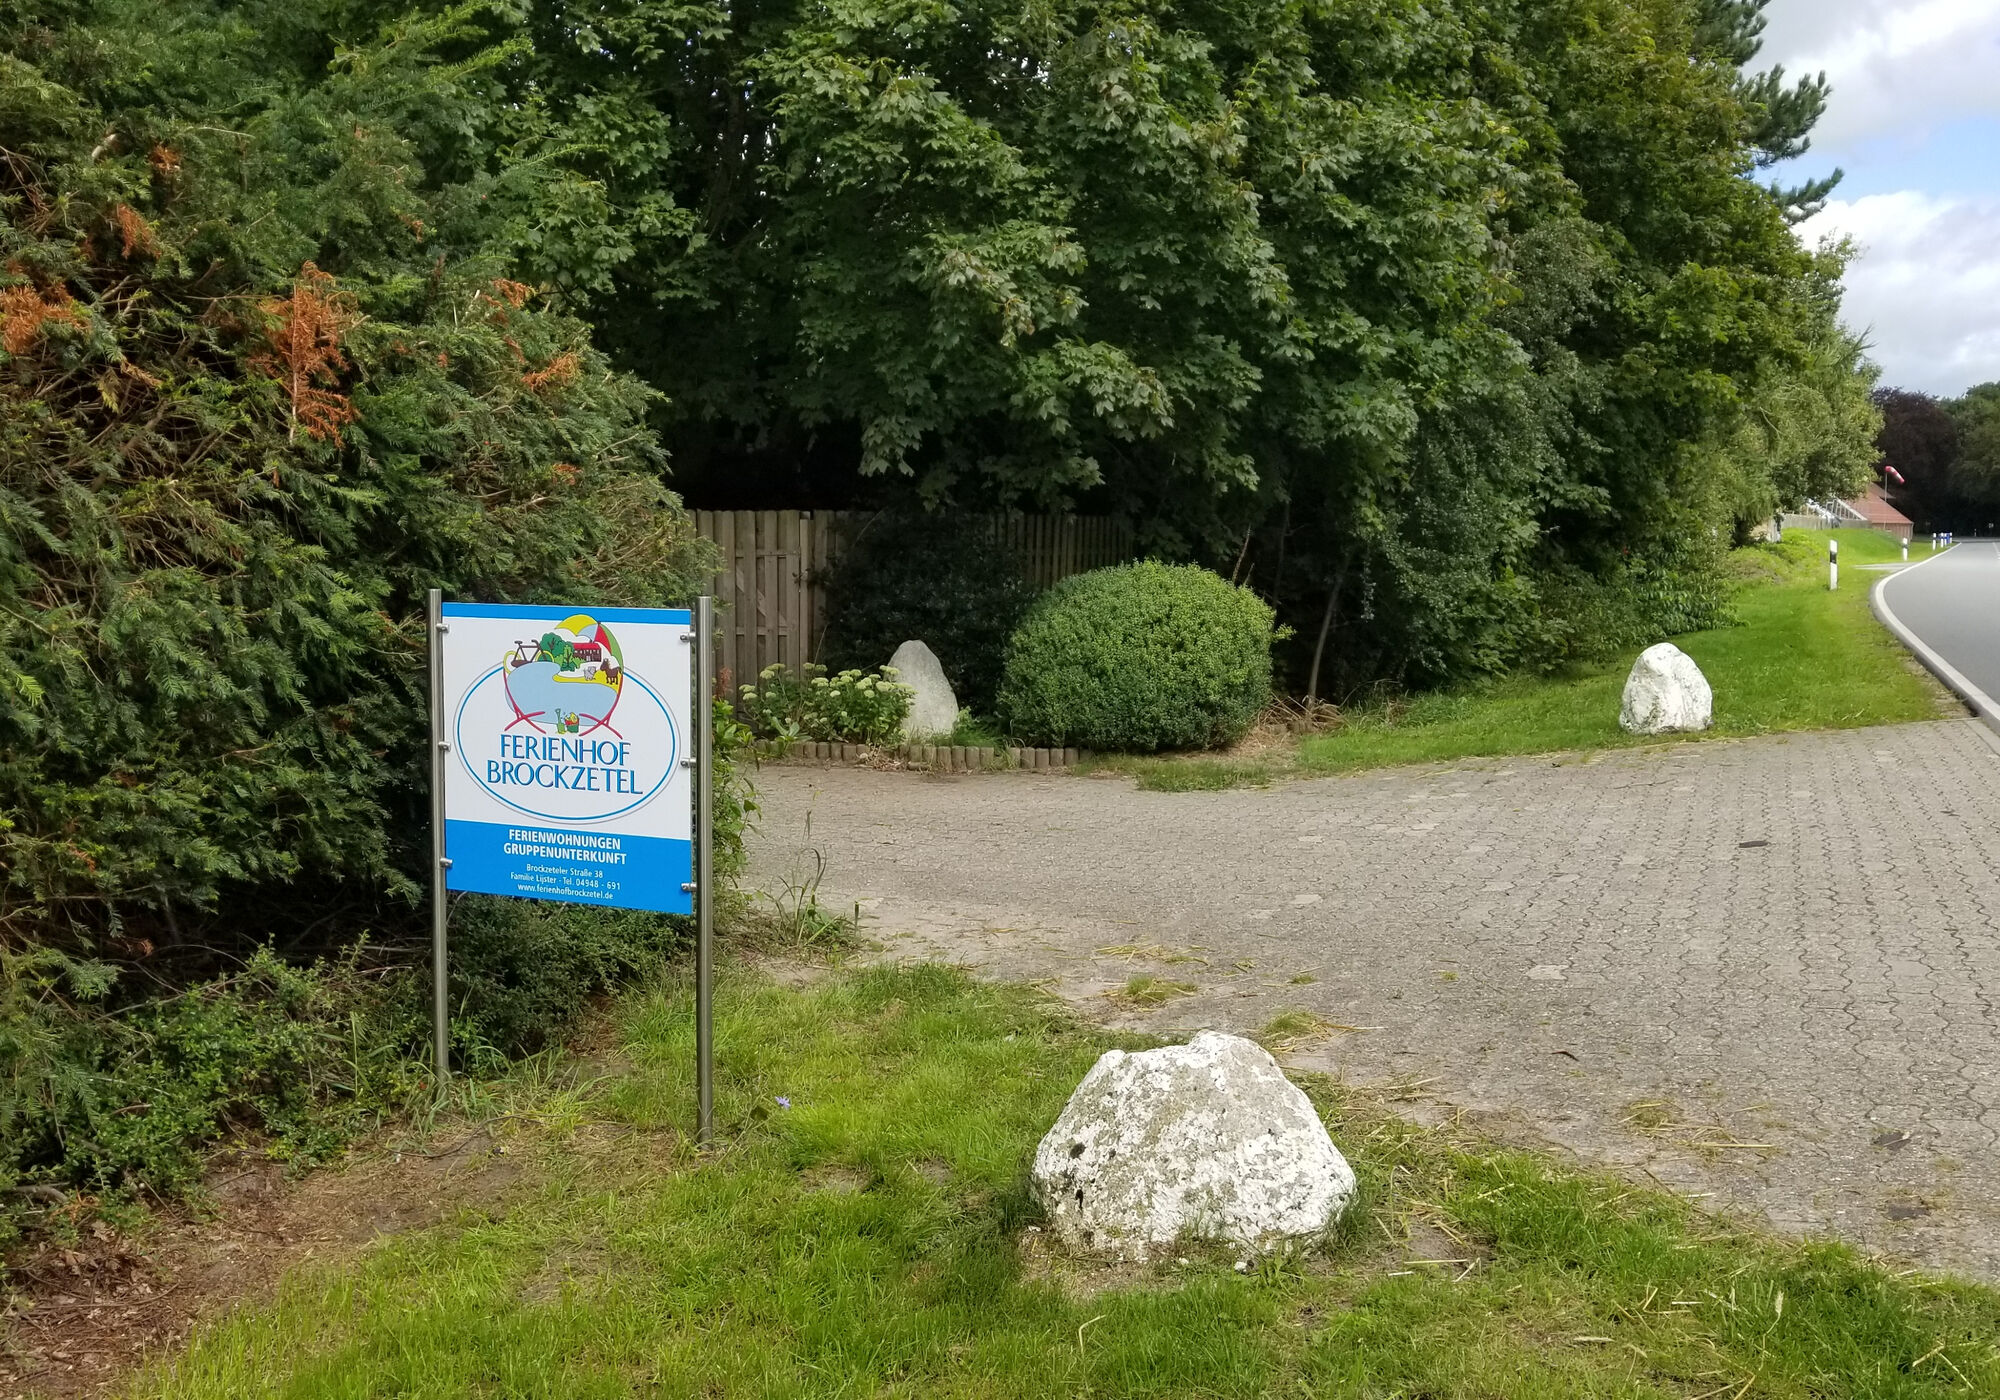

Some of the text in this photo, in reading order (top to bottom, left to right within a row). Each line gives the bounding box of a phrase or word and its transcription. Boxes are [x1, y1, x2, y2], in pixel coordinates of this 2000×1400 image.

[500, 734, 631, 766] FERIENHOF
[487, 759, 643, 795] BROCKZETEL
[509, 829, 620, 850] FERIENWOHNUNGEN
[503, 842, 627, 865] GRUPPENUNTERKUNFT
[510, 871, 534, 882] Familie
[575, 878, 599, 889] 04948
[606, 881, 620, 891] 691
[526, 863, 604, 879] Brockzeteler Straße 38
[517, 883, 614, 900] www.ferienhofbrockzetel.de
